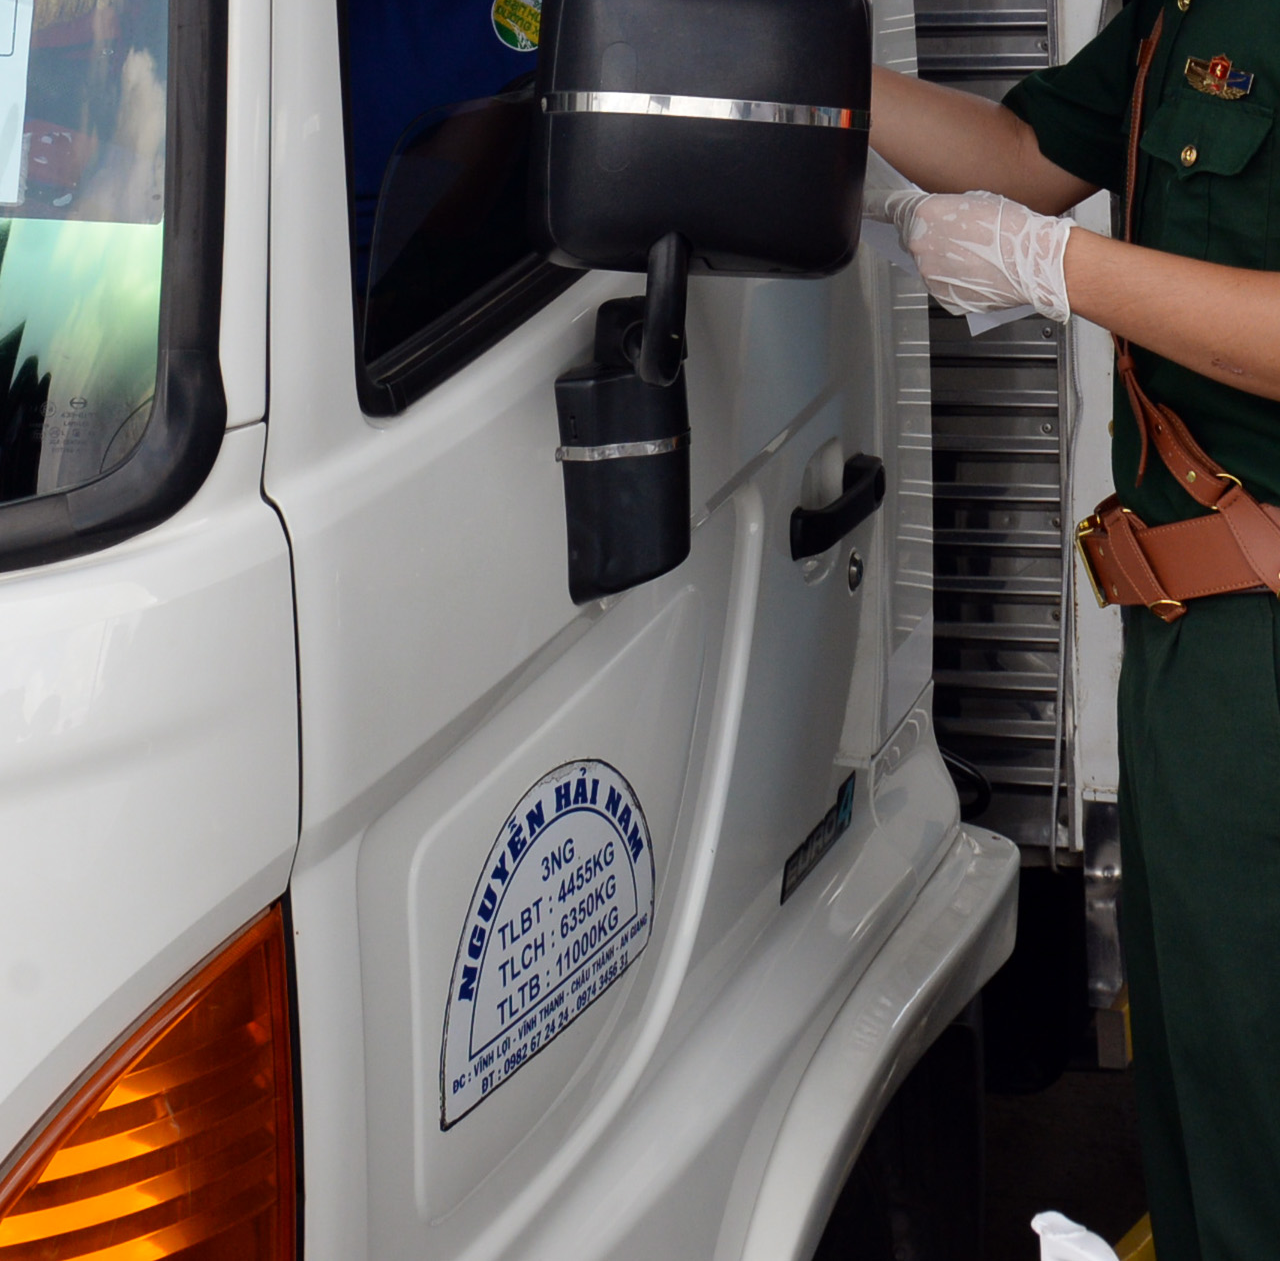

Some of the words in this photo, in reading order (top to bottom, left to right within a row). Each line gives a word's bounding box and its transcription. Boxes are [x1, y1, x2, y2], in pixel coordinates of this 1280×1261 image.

[458, 800, 545, 1001] NGUYỄN
[555, 767, 600, 813] HẢI
[605, 785, 644, 864] NAM
[498, 897, 543, 951] TLBT
[558, 841, 615, 904] 4455KG
[541, 838, 575, 882] 3NG
[497, 973, 540, 1026] TLTB
[556, 906, 619, 977] 11000KG
[498, 932, 546, 988] TLCH
[560, 874, 617, 939] 6350KG
[452, 1073, 466, 1095] ĐC
[473, 1050, 494, 1077] VĨNH
[518, 1014, 537, 1041] VĨNH
[571, 968, 591, 995] CHÂU
[592, 944, 615, 976] THÀNH
[620, 933, 629, 950] AN
[630, 912, 648, 939] GIANG
[481, 1071, 495, 1095] ĐT
[504, 1042, 528, 1075] 0982
[530, 1030, 542, 1053] 67
[544, 1018, 556, 1041] 24
[558, 1006, 569, 1029] 24
[576, 981, 597, 1012] 0974
[599, 960, 618, 991] 3456
[620, 950, 629, 971] 31
